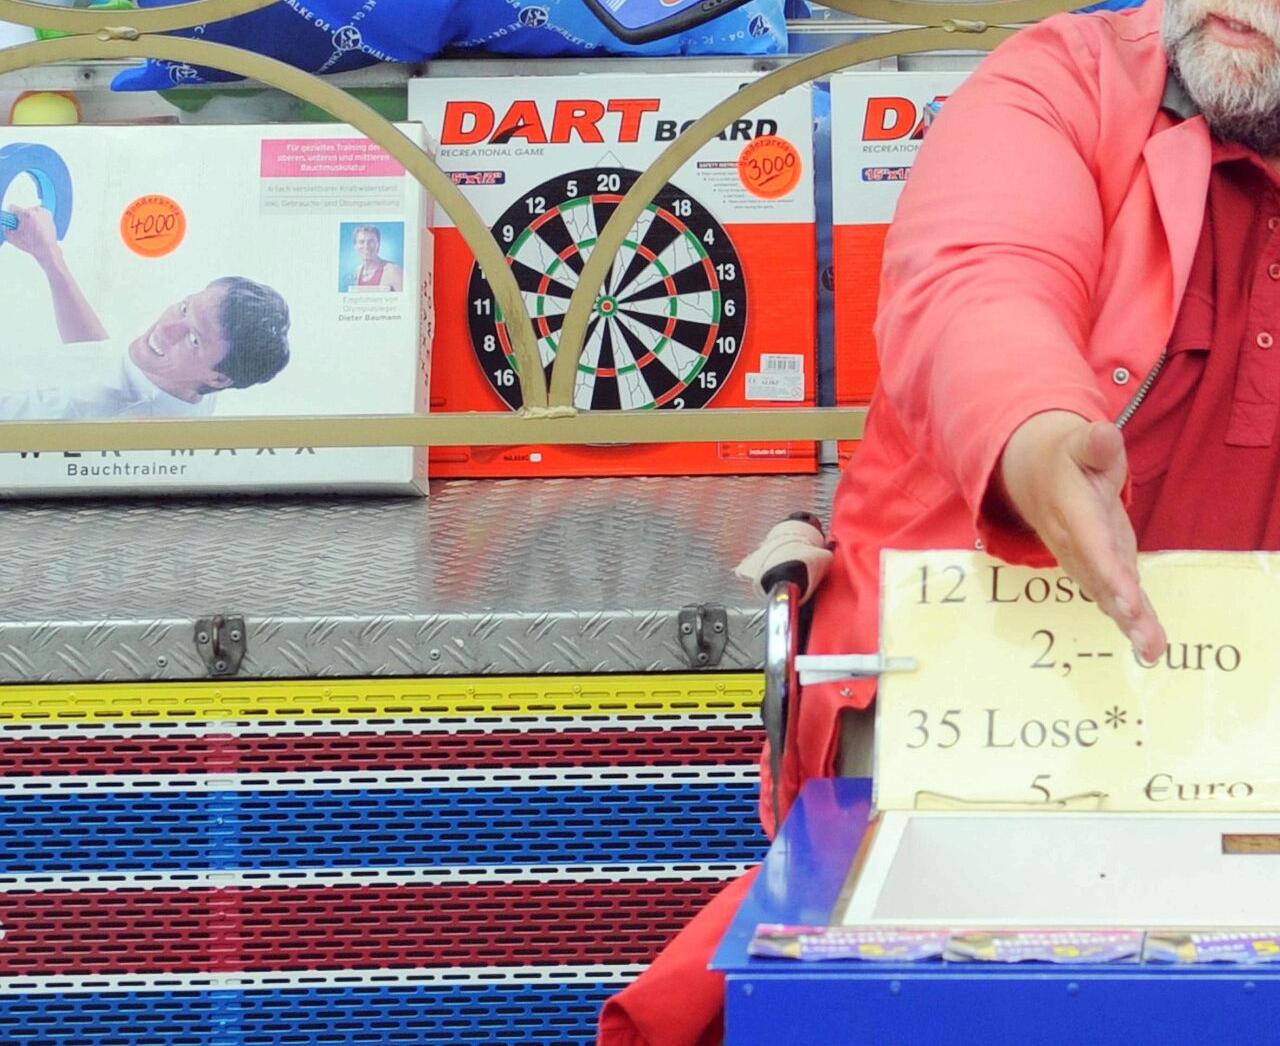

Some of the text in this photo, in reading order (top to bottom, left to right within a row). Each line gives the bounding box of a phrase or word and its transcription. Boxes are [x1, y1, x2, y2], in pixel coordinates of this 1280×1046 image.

[440, 98, 661, 145] DART
[336, 143, 367, 153] Training
[439, 148, 545, 157] RECREATIONAL GAME
[338, 153, 353, 162] und
[747, 152, 796, 181] 3000
[566, 181, 578, 198] 5
[597, 173, 620, 192] 20
[526, 197, 545, 214] 12
[672, 199, 692, 217] 18
[130, 213, 175, 236] 4000
[502, 226, 514, 242] 9
[703, 229, 715, 245] 4
[717, 263, 736, 281] 13
[473, 299, 491, 317] 11
[724, 299, 735, 316] 6
[338, 314, 402, 322] Dieter Baumann
[483, 336, 495, 353] 8
[717, 336, 736, 354] 10
[494, 370, 515, 387] 16
[699, 371, 717, 389] 15
[66, 462, 189, 477] Bauchtrainer
[916, 564, 967, 605] 12
[905, 708, 962, 750] 35
